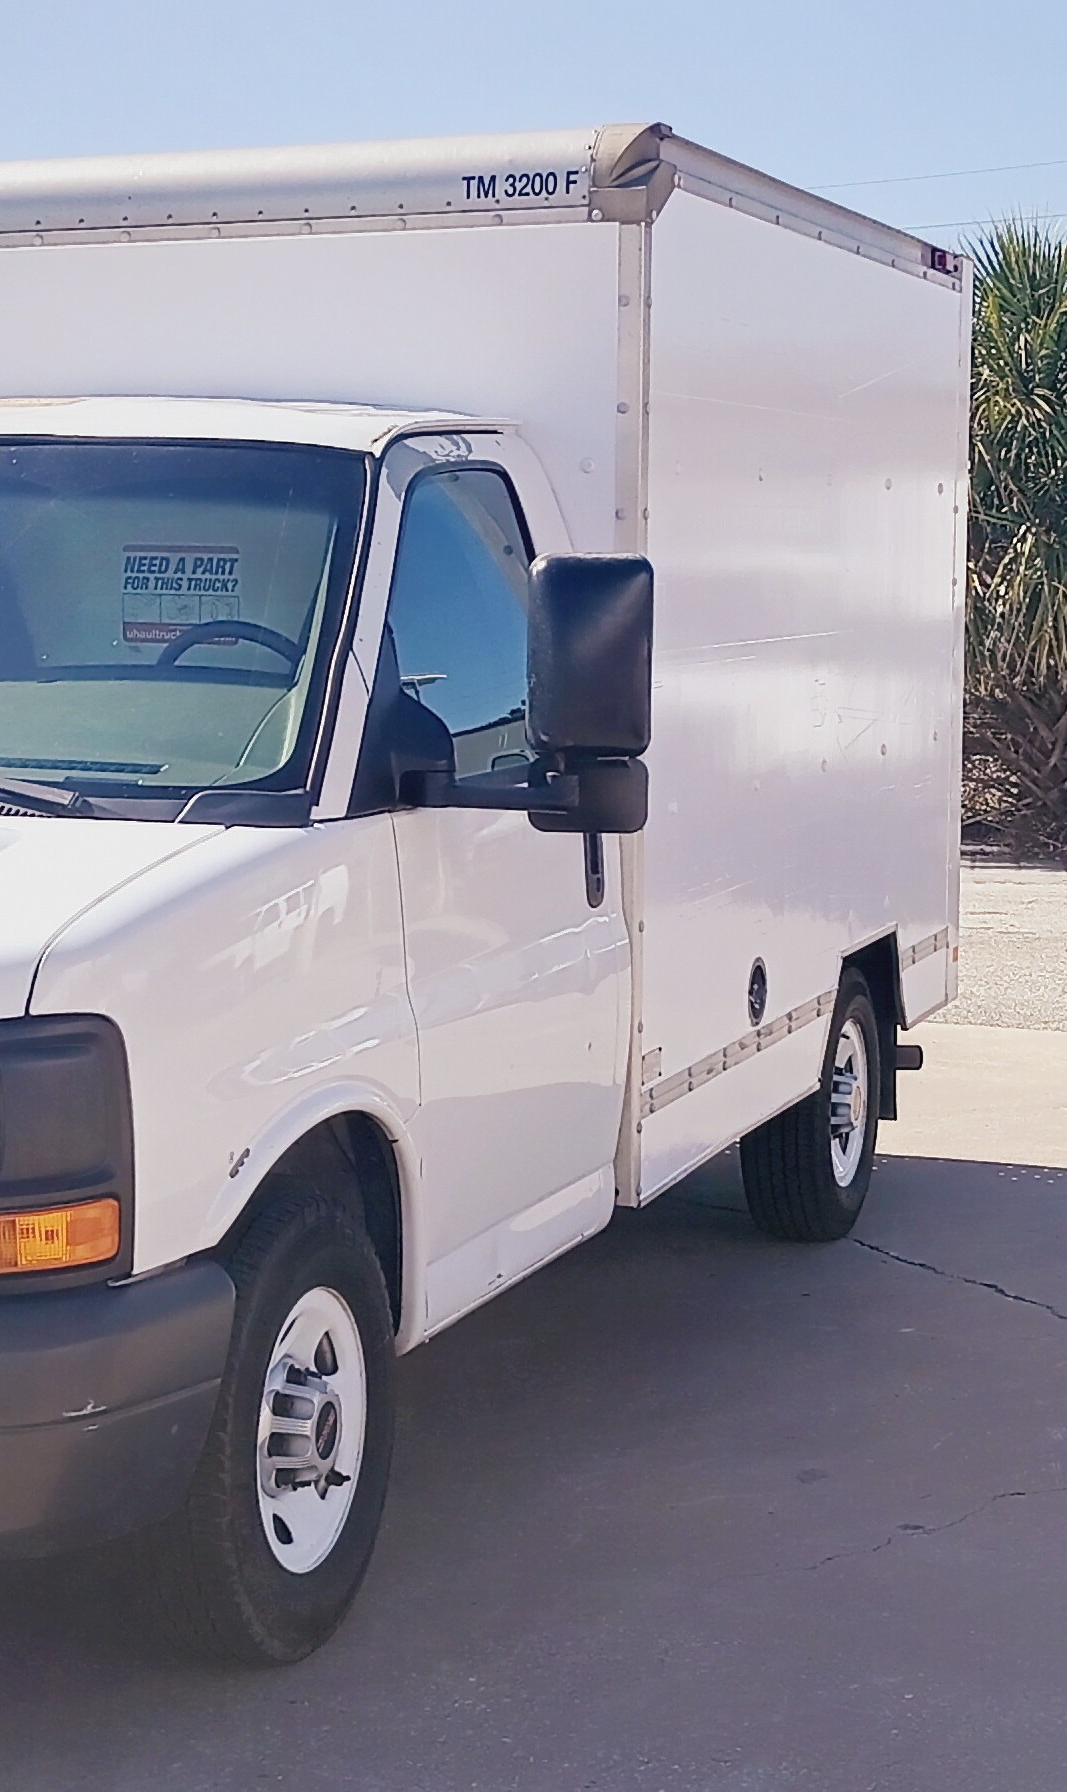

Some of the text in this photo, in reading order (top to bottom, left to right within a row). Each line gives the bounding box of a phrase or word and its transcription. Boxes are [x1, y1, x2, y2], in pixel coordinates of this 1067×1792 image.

[462, 170, 579, 199] TM 3200 F
[124, 555, 239, 576] NEED A PART
[123, 576, 239, 593] FOR THIS TRUCK?
